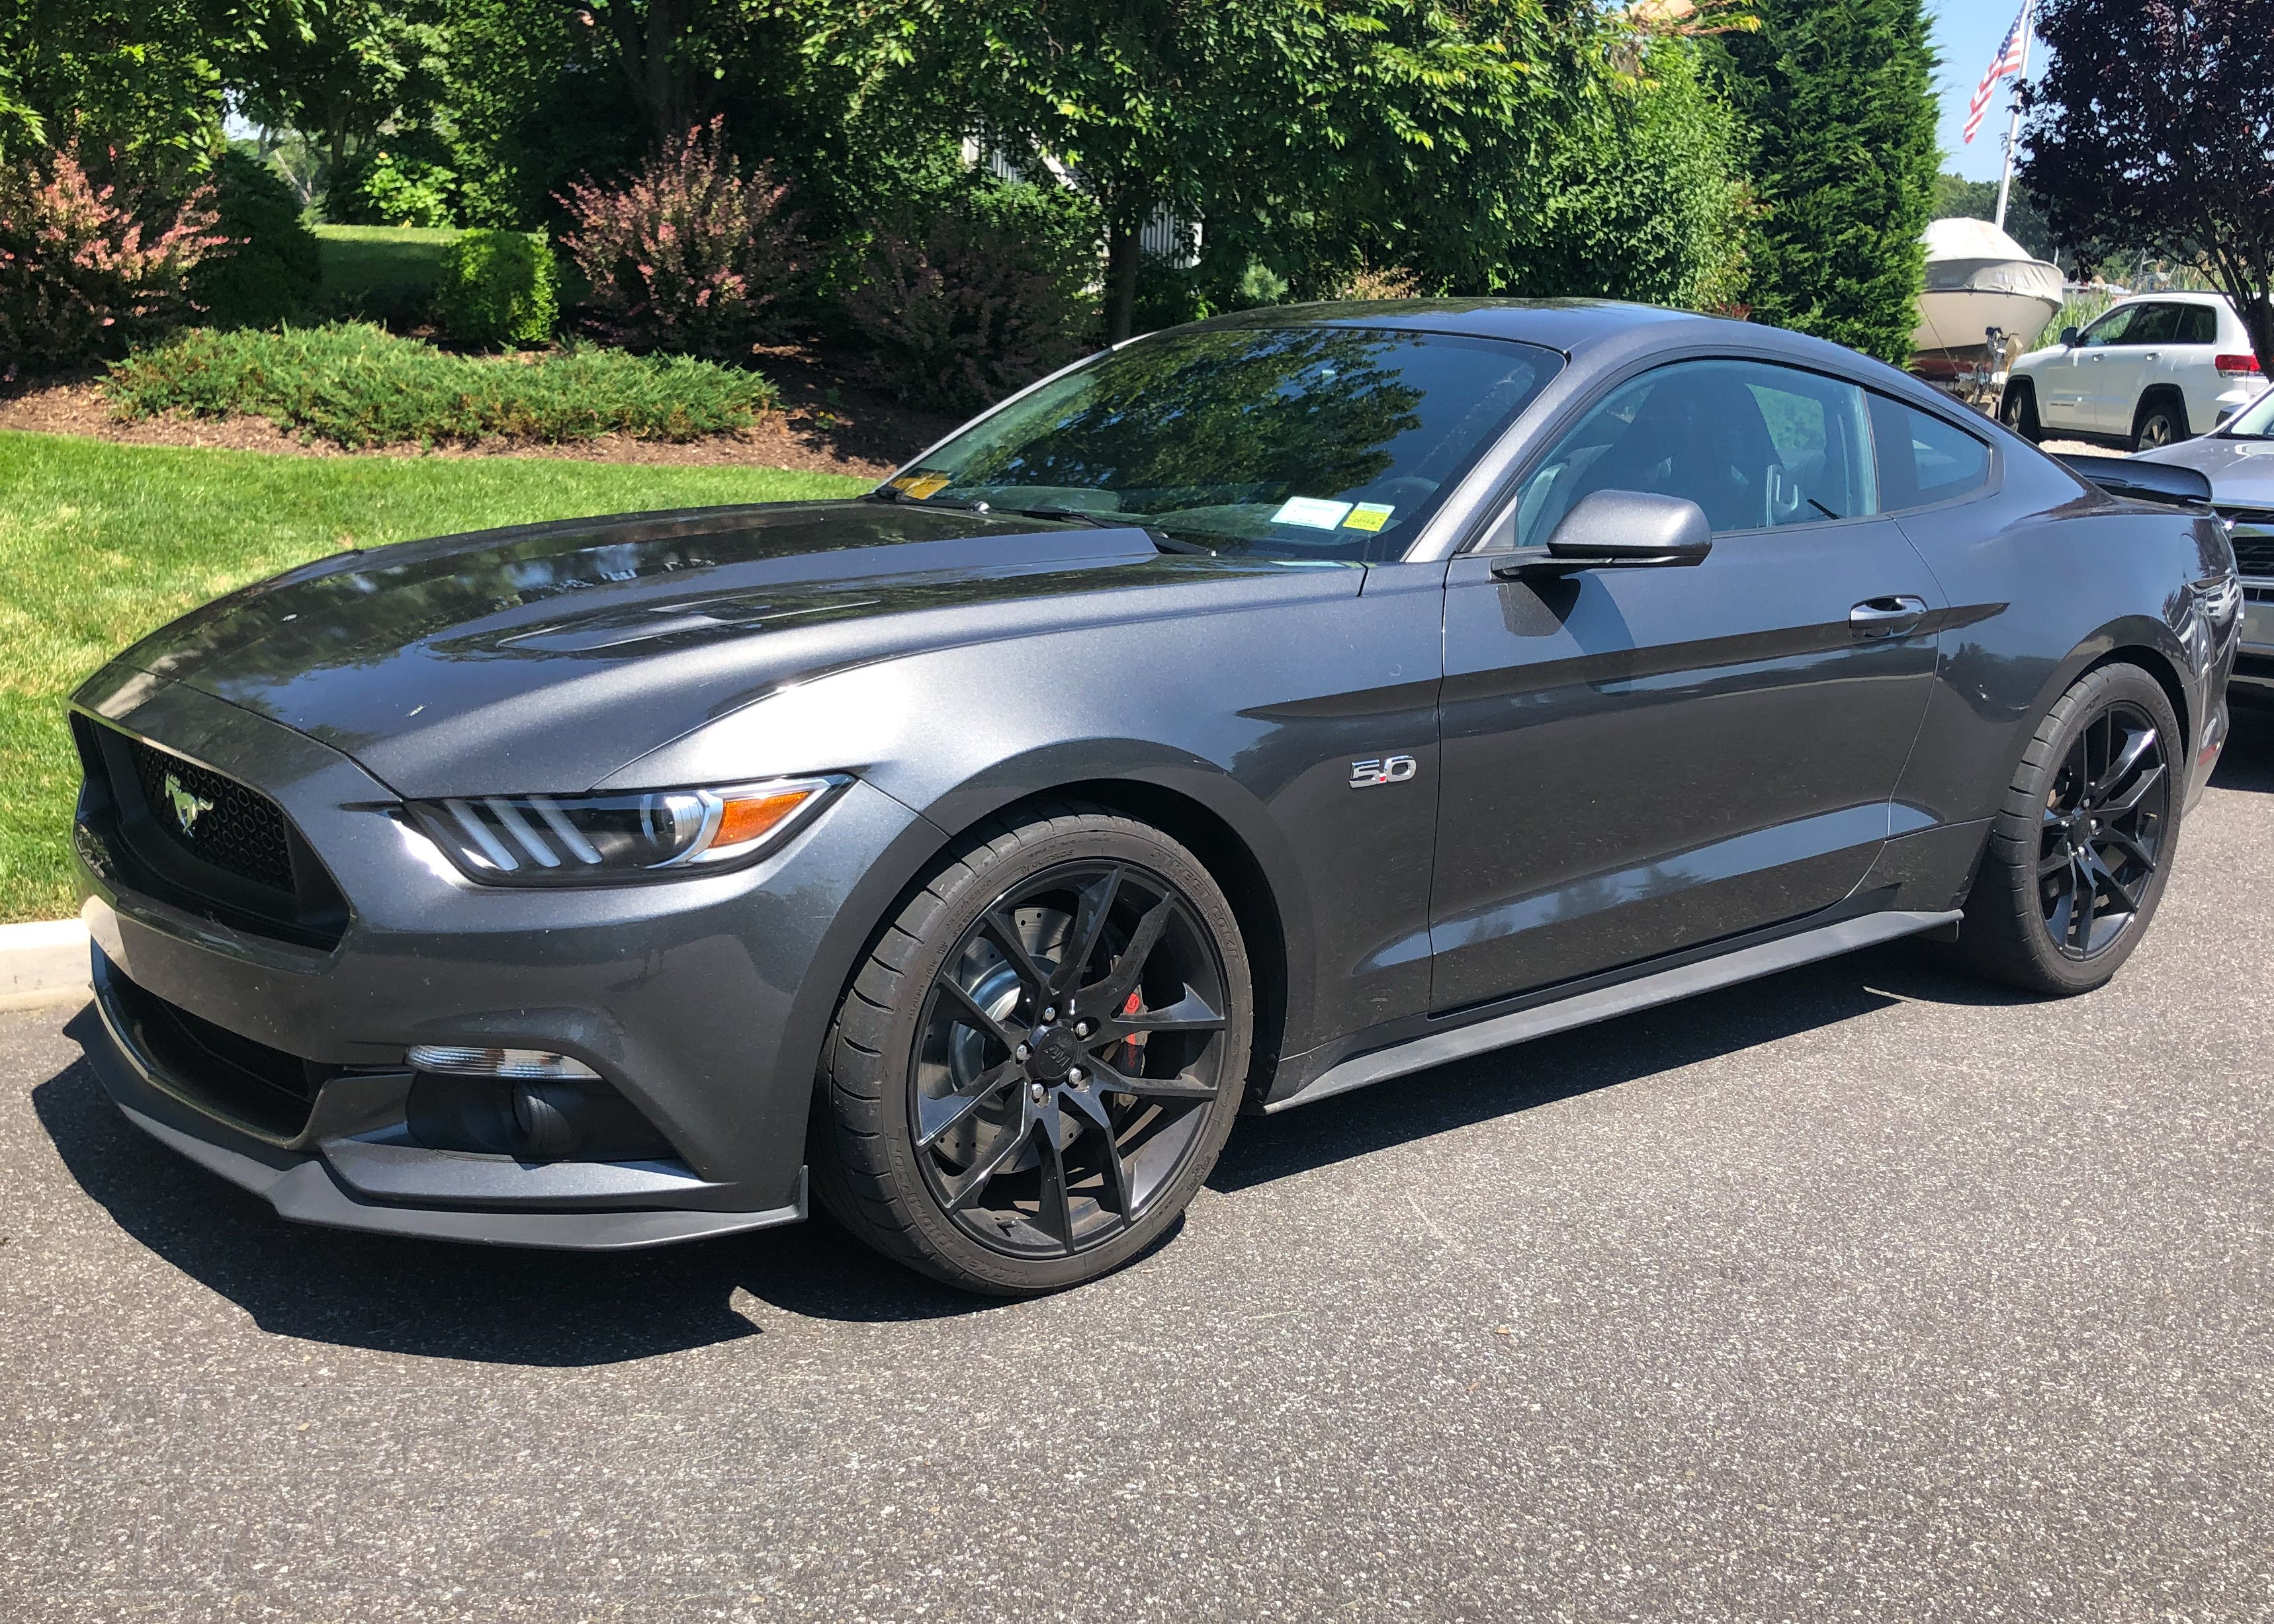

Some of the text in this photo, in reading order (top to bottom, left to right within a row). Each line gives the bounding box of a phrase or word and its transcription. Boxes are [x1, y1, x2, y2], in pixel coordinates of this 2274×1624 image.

[1348, 755, 1417, 789] 5.0
[1149, 847, 1211, 898] STREET
[889, 1137, 955, 1251] THOMPSON
